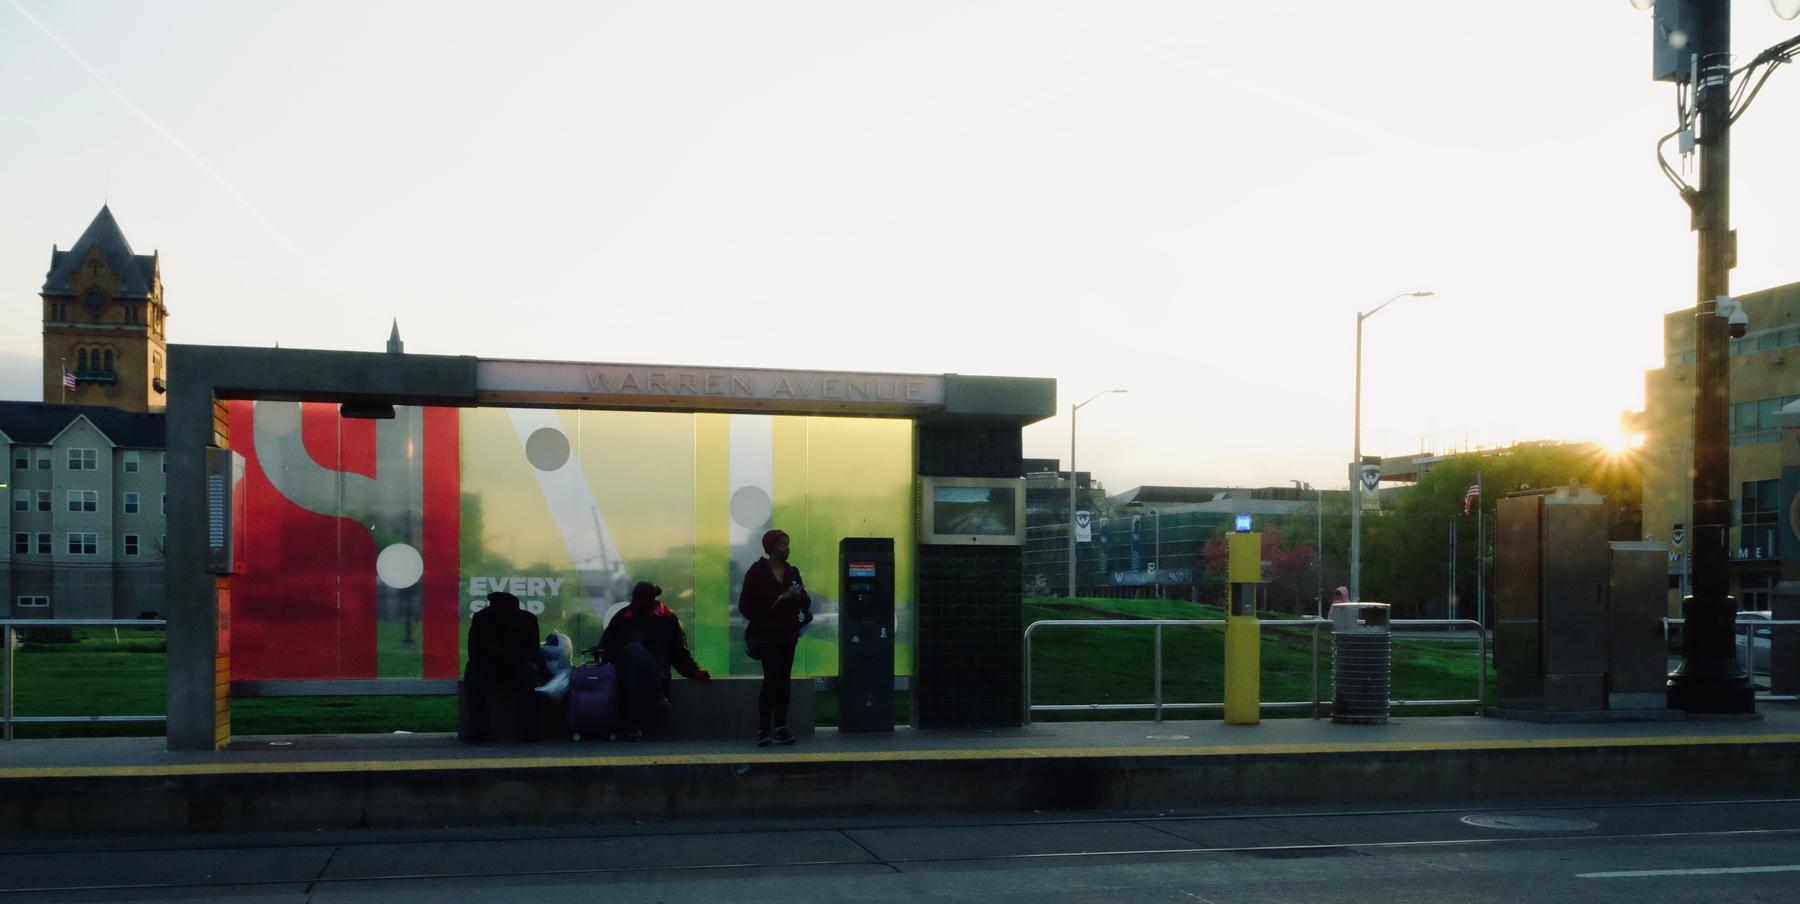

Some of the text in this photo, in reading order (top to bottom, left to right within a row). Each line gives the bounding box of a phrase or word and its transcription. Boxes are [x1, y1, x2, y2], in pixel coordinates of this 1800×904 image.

[584, 367, 926, 400] WARREN AVENUE
[469, 576, 565, 596] EVERY
[469, 600, 545, 618] SP
